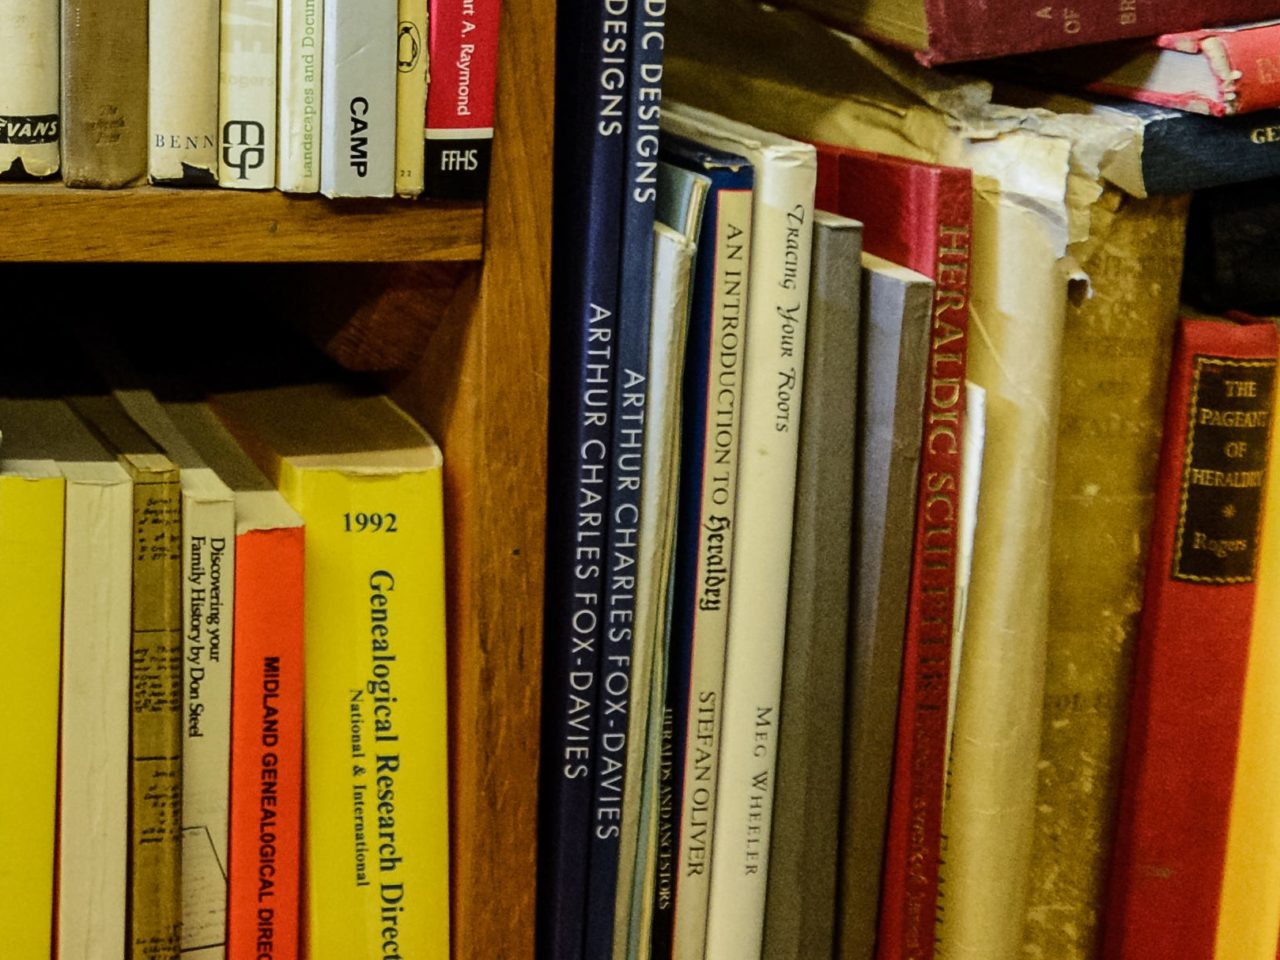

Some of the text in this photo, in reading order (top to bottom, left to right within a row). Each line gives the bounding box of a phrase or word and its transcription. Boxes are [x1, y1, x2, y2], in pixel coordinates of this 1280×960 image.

[462, 20, 476, 39] A.
[1036, 6, 1052, 20] A
[1064, 7, 1081, 34] OF
[456, 44, 475, 116] Raymond
[155, 134, 214, 148] BENN
[350, 97, 369, 178] CAMP
[440, 149, 478, 171] FFHS
[632, 62, 665, 205] DESIGNS
[726, 223, 744, 261] AN
[713, 270, 742, 467] INTRODUCTION
[1225, 381, 1257, 397] THE
[1224, 442, 1247, 458] OF
[712, 472, 732, 506] TO
[342, 512, 398, 533] 1992
[562, 302, 614, 782] ARTHUR CHARLES FOX-DAVIES
[206, 537, 226, 662] Discovering your
[595, 367, 647, 842] ARTHUR CHARLES FOX-DAVIES
[366, 569, 405, 960] Genealogical Research Direct
[685, 689, 717, 878] STEFAN OLIVER
[255, 655, 280, 960] MIDLAND GENEALOGICAL DIREC
